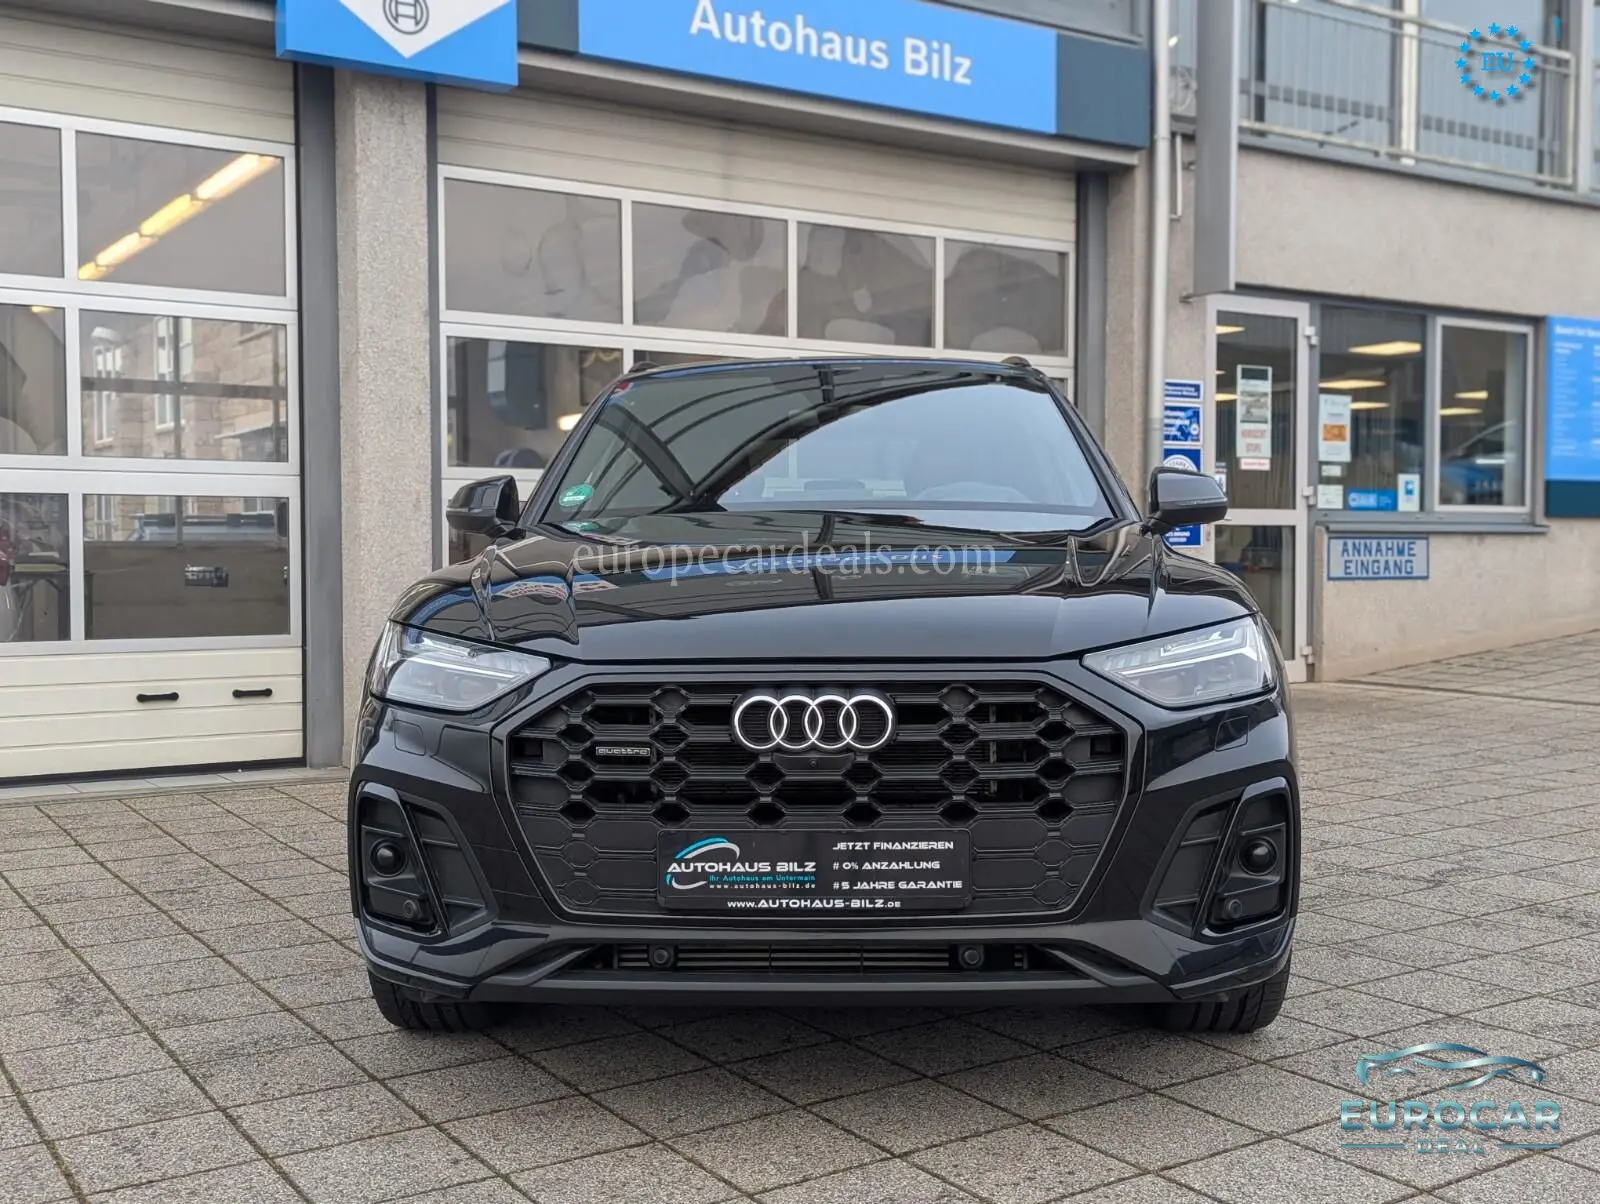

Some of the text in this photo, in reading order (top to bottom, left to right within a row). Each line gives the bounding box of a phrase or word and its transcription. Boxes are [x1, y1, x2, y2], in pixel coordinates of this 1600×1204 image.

[689, 0, 973, 86] Autohaus Bilz
[1341, 541, 1417, 558] ANNAHME
[1343, 559, 1415, 576] EINGANG
[832, 841, 954, 851] JETZT FINANZIEREN
[667, 862, 817, 873] AUTOHAUS BILZ
[842, 861, 859, 870] 0%
[862, 861, 941, 870] ANZAHLUNG
[709, 874, 719, 882] Ihr
[853, 881, 895, 890] JAHRE
[898, 881, 963, 889] GARANTIE
